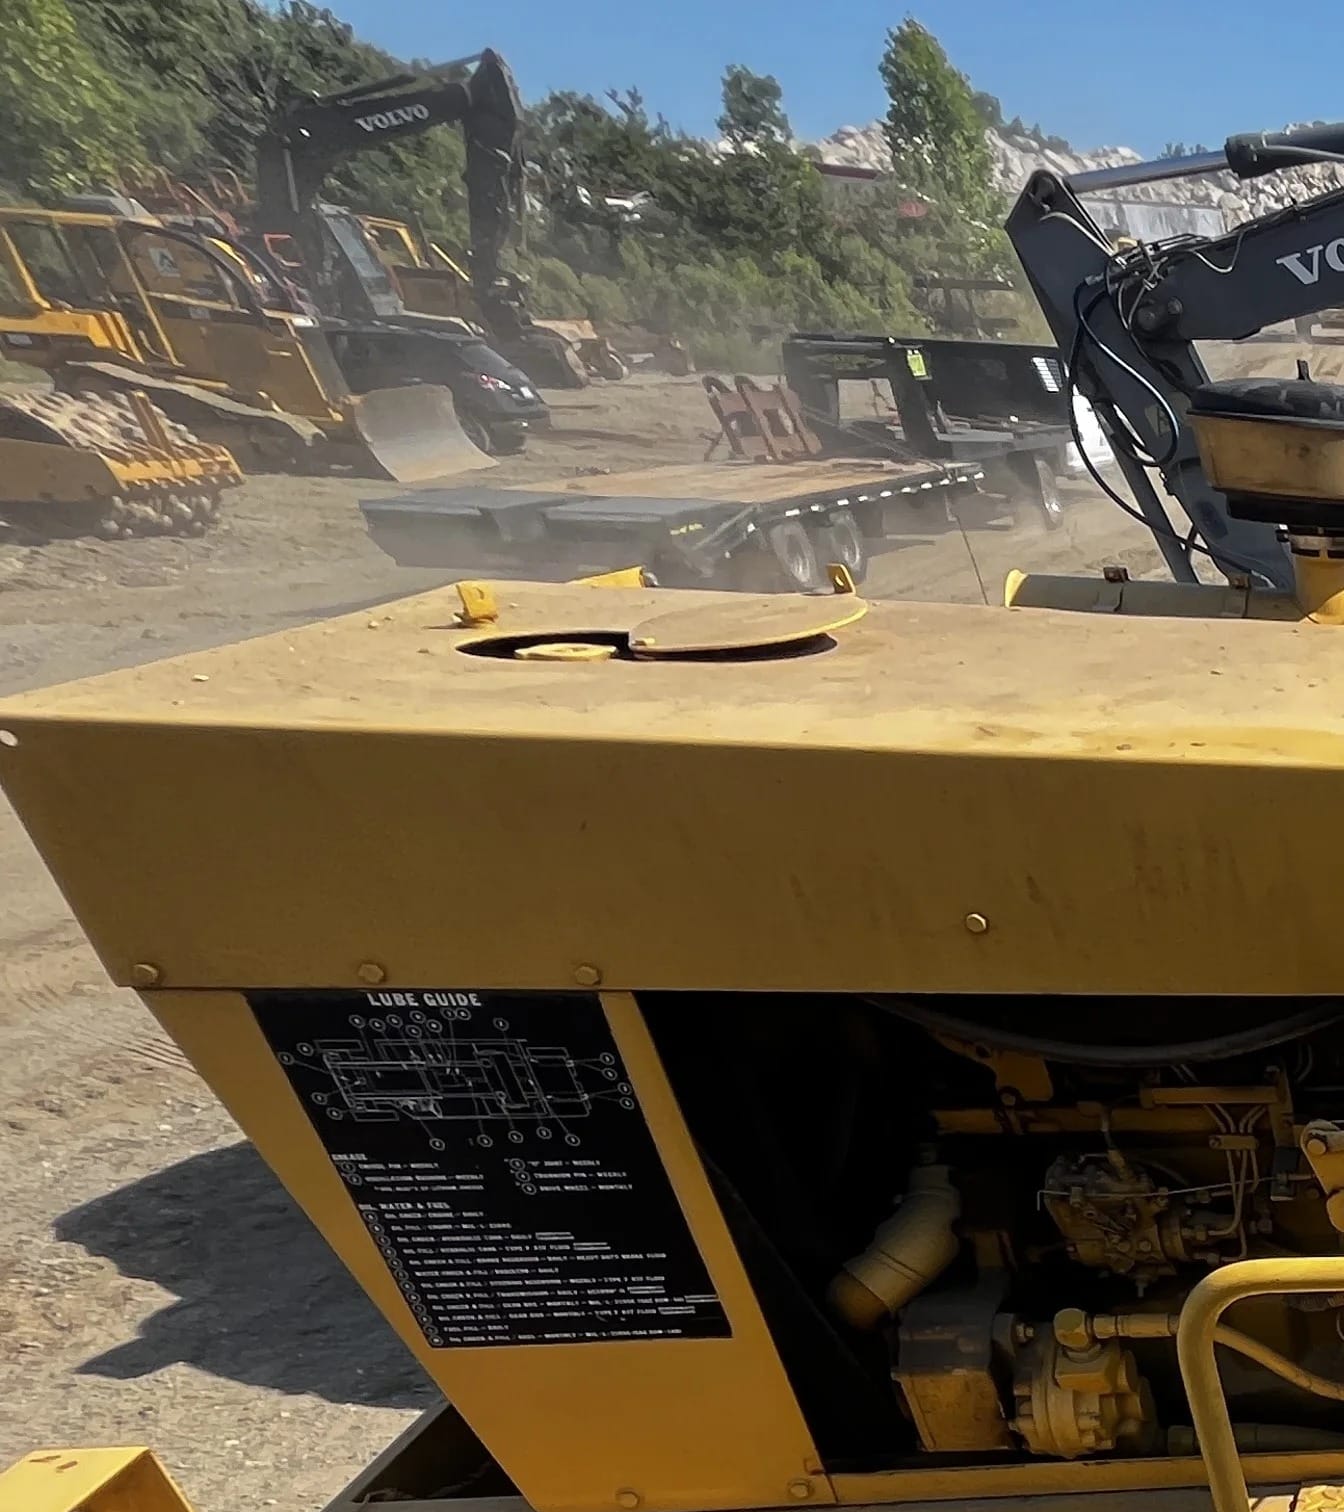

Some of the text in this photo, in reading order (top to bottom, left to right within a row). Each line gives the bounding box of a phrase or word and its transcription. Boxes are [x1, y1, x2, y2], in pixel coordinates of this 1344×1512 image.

[354, 104, 429, 132] VOLVO
[366, 992, 482, 1007] LUBE GUIDE
